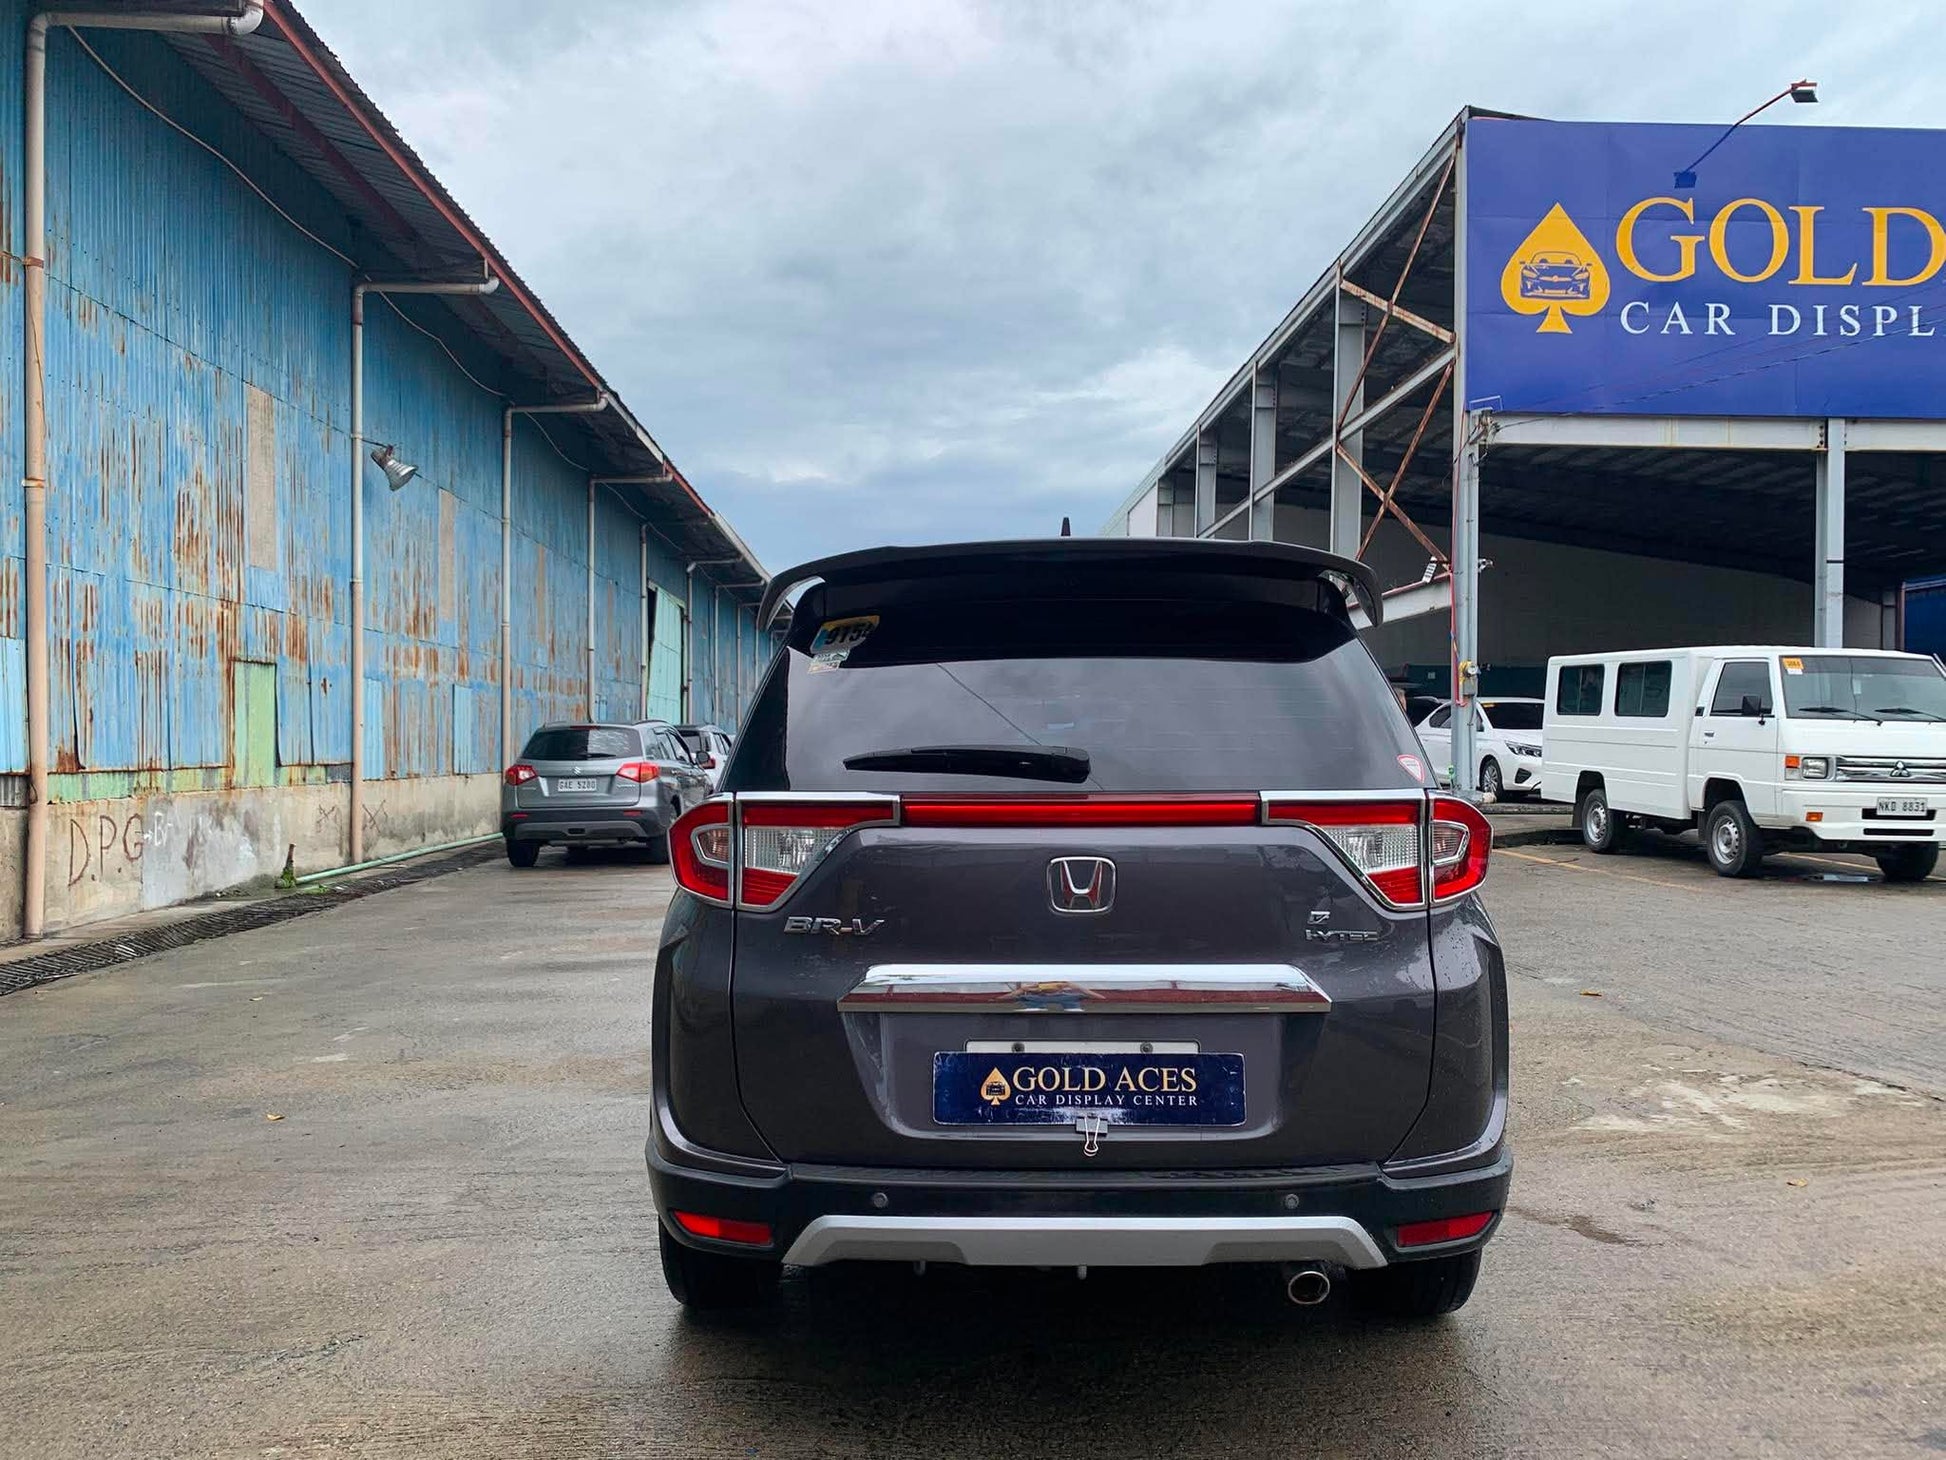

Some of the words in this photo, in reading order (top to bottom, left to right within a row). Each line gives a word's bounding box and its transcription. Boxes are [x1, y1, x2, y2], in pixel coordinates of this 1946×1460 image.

[1615, 196, 1946, 287] GOLD
[1620, 301, 1736, 336] CAR
[1768, 304, 1946, 337] DISPL
[784, 916, 885, 935] BR-V
[1012, 1066, 1106, 1092] GOLD
[1114, 1066, 1197, 1092] ACES
[1015, 1095, 1047, 1105] CAR
[1056, 1095, 1125, 1105] DISPLAY
[1133, 1095, 1198, 1106] CENTER
